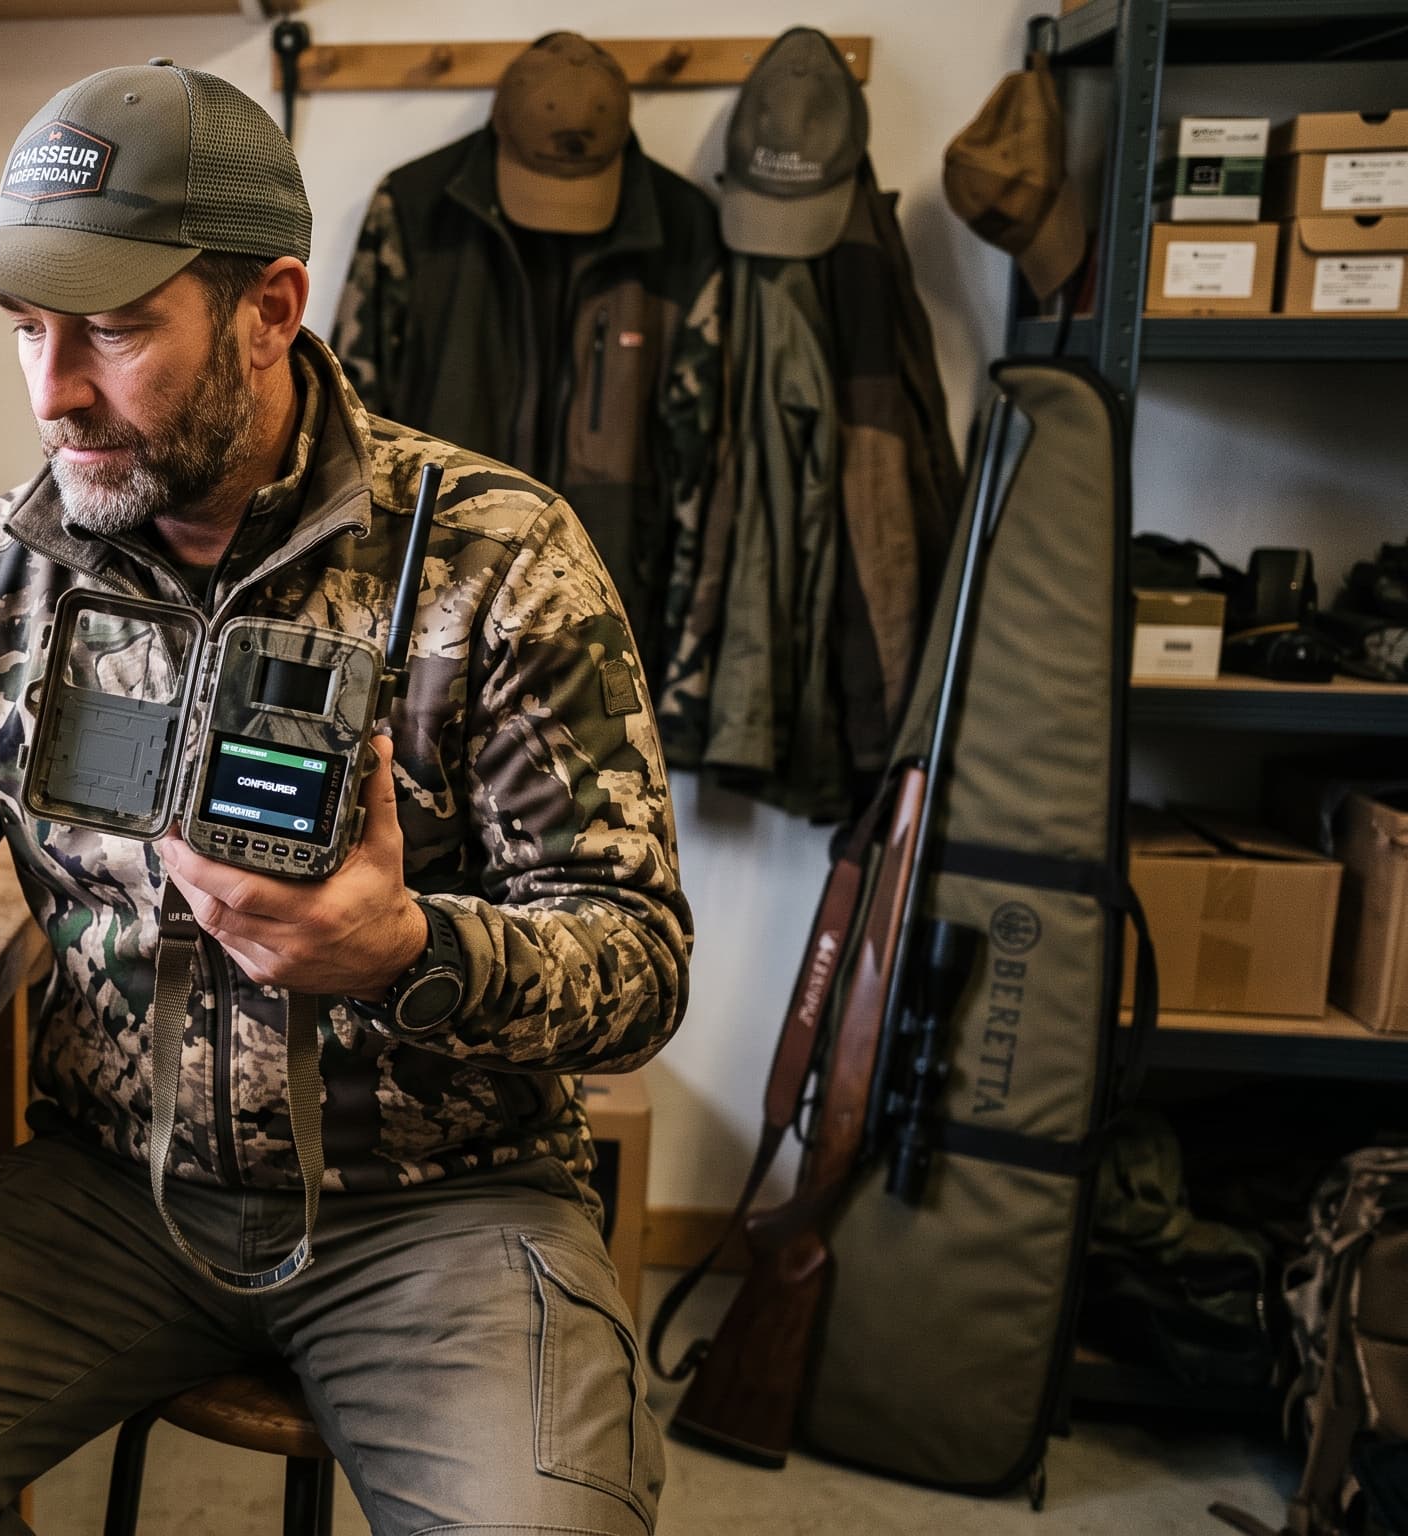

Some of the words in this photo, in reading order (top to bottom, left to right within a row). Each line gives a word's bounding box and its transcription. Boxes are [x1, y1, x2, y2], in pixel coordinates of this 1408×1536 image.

[11, 144, 99, 170] CHASSEUR
[236, 776, 298, 796] CONFIGURER
[972, 959, 1028, 1115] BERETTA
